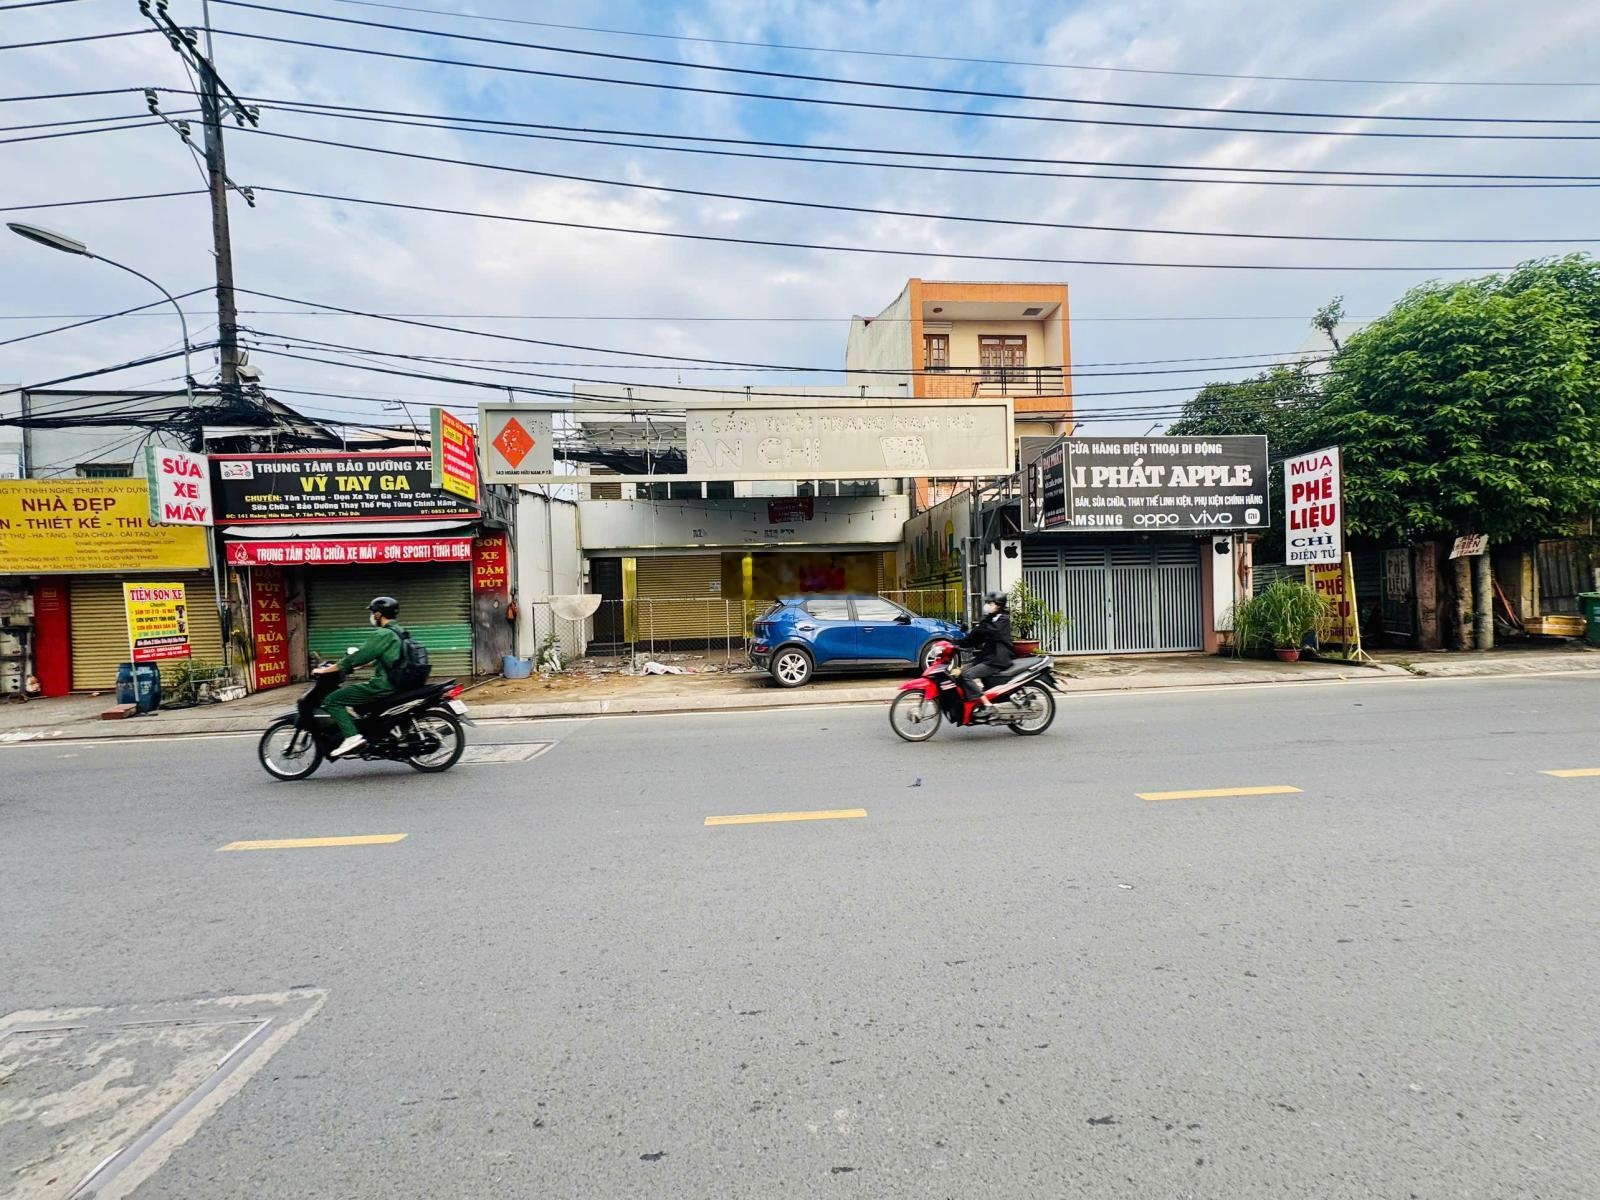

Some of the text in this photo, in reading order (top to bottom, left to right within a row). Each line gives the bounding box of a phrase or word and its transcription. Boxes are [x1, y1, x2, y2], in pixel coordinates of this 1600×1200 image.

[1069, 441, 1222, 456] CỬA HÀNG ĐIỆN THOẠI DI ĐỘNG
[162, 454, 203, 478] SỬA
[255, 459, 432, 473] TRUNG TÂM BẢO DƯỠNG XE
[1091, 458, 1165, 487] PHÁT
[1168, 464, 1253, 487] APPLE
[1291, 455, 1333, 476] MUA
[300, 473, 410, 492] VỸ TAY GA
[1291, 470, 1333, 504] PHẾ
[173, 481, 198, 499] XE
[244, 494, 282, 502] CHUYÊN:
[302, 494, 326, 502] Trang
[365, 493, 379, 501] Tay
[400, 492, 412, 500] Tay
[21, 495, 116, 514] NHÀ ĐẸP
[341, 501, 358, 509] Thay
[1093, 495, 1107, 507] SỬA
[1128, 497, 1144, 506] THAY
[1146, 494, 1158, 506] THẾ
[1160, 496, 1175, 506] LINH
[1194, 496, 1207, 507] PHỤ
[1208, 495, 1223, 507] KIỆN
[1224, 494, 1244, 505] CHÍNH
[1245, 494, 1263, 505] HÃNG
[164, 502, 206, 521] MÁY
[1190, 510, 1232, 523] vivo
[1290, 502, 1335, 533] LIỆU
[26, 516, 72, 529] THIẾT
[79, 516, 101, 528] KẾ
[116, 517, 142, 528] THI
[1133, 513, 1179, 527] oppo
[475, 538, 502, 547] SƠN
[1291, 532, 1333, 547] CHÌ
[257, 548, 283, 561] TRUNG
[285, 545, 302, 561] TÂM
[305, 543, 320, 561] SỬA
[323, 544, 345, 560] CHỮA
[347, 546, 357, 560] XE
[359, 544, 377, 559] MÁY
[384, 544, 400, 559] SƠN
[432, 543, 450, 557] TĨNH
[452, 543, 470, 560] ĐIỆN
[481, 551, 499, 560] XE
[1290, 546, 1336, 562] ĐIỆN TỬ
[477, 564, 504, 576] DẶM
[130, 587, 151, 602] TIỆM
[172, 589, 183, 600] XE
[260, 613, 280, 622] XE
[257, 630, 284, 642] RỬA
[264, 645, 280, 653] XE
[259, 661, 286, 672] THAY
[260, 673, 287, 686] NHỚT
